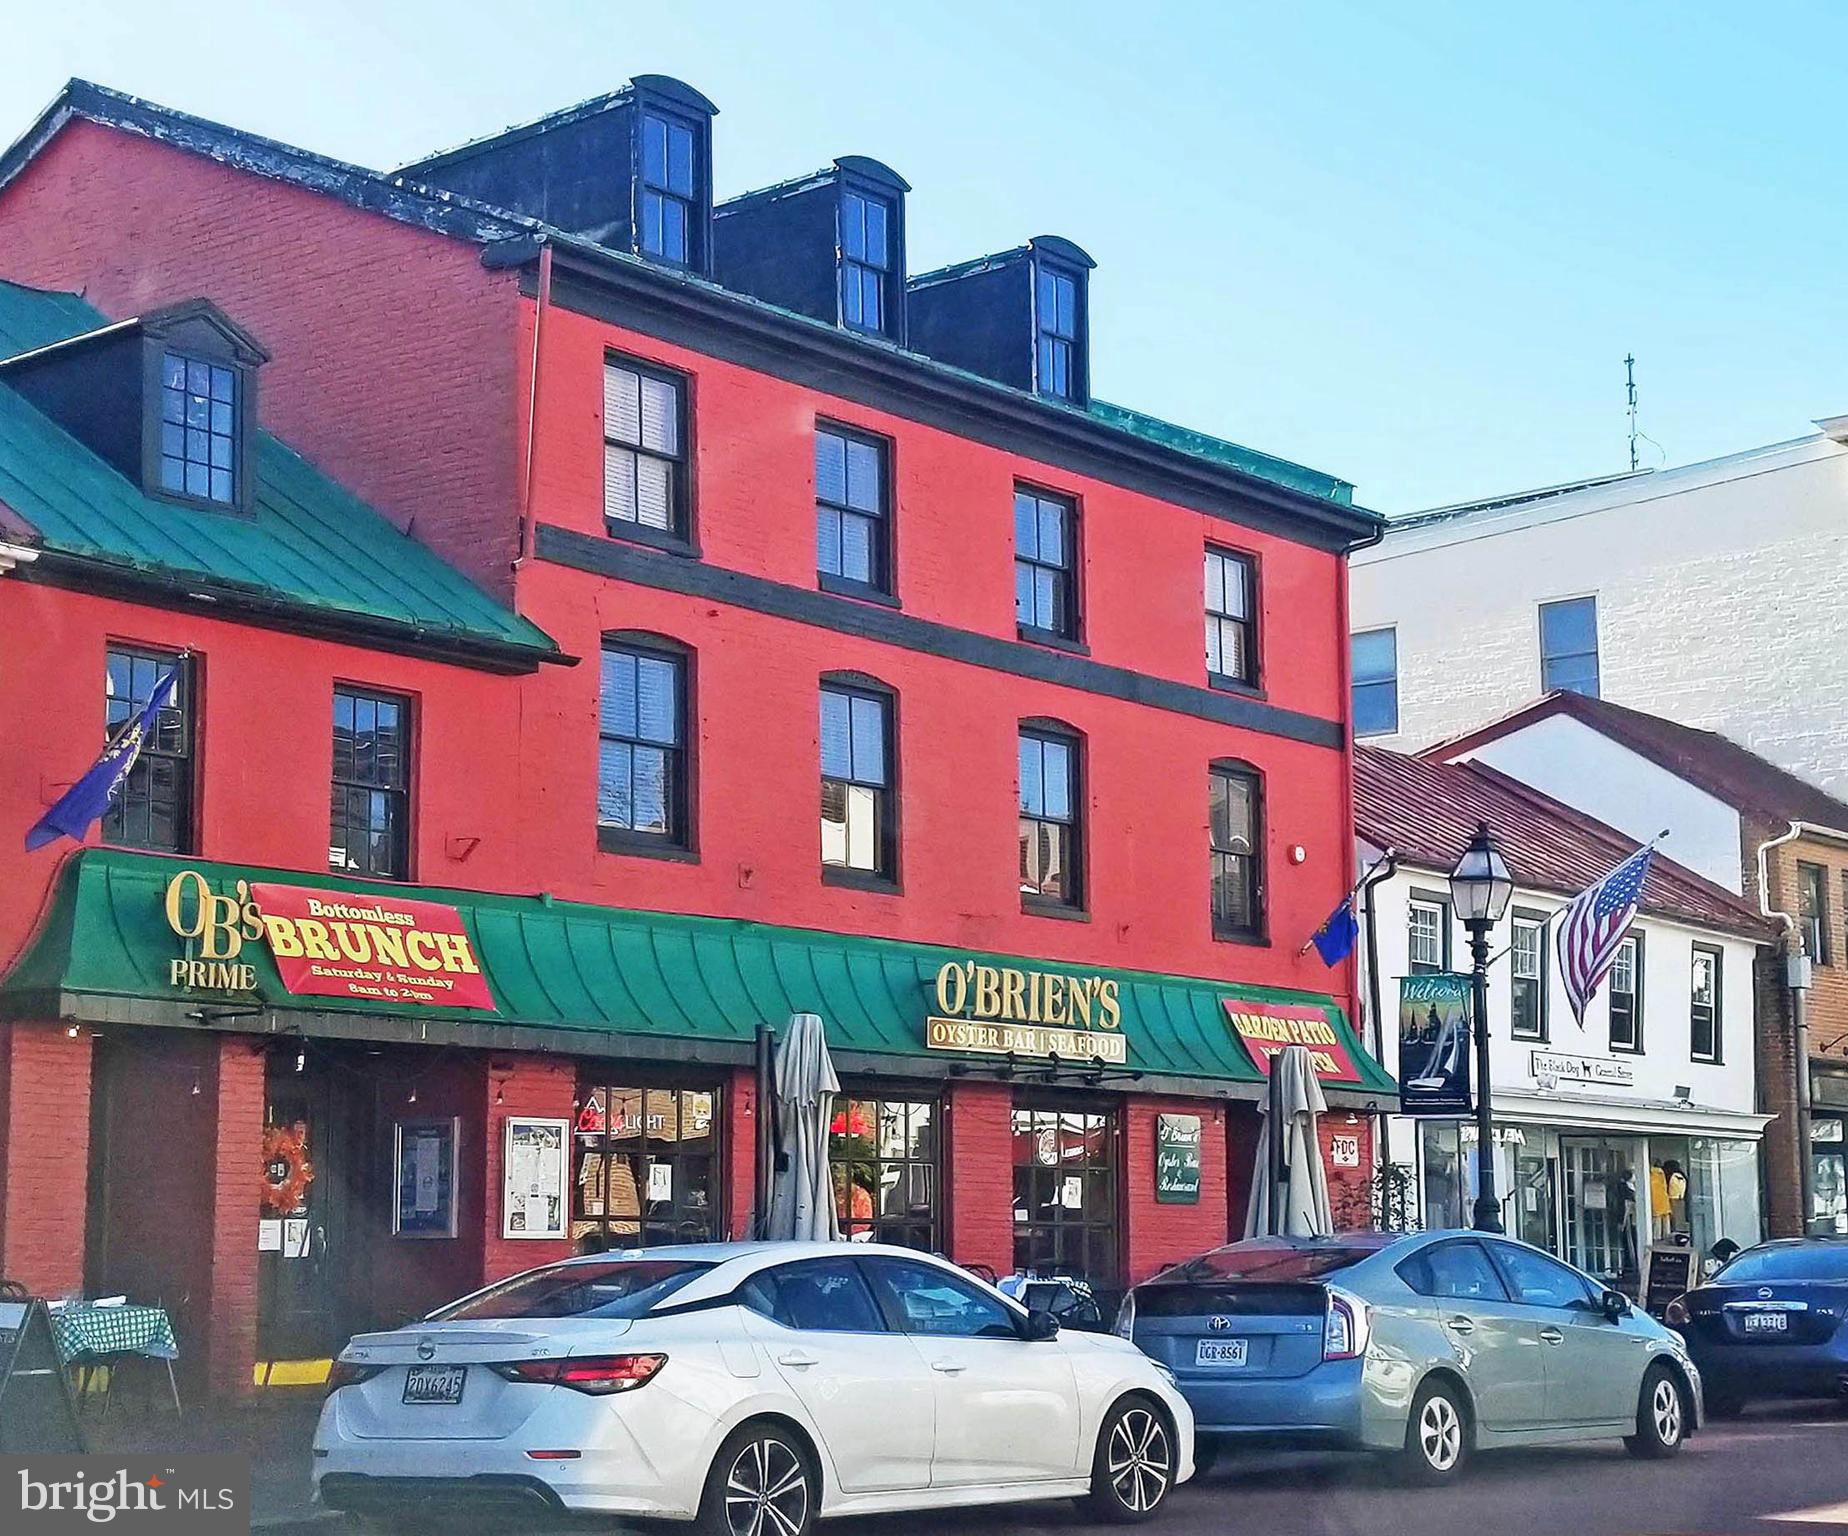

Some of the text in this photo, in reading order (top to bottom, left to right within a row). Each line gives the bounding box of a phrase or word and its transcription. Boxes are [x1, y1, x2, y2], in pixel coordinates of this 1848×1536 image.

[307, 898, 415, 927] Bottomless
[262, 914, 480, 974] BRUNCH
[170, 959, 258, 990] PRIME
[311, 965, 382, 983] Saturday
[396, 973, 455, 990] Sunday
[383, 986, 399, 998] to
[936, 960, 1121, 1030] O'BRIEN'S
[933, 1023, 1121, 1057] OYSTER BAR SEAFOOD
[1230, 1012, 1337, 1046] GARDEN PATIO
